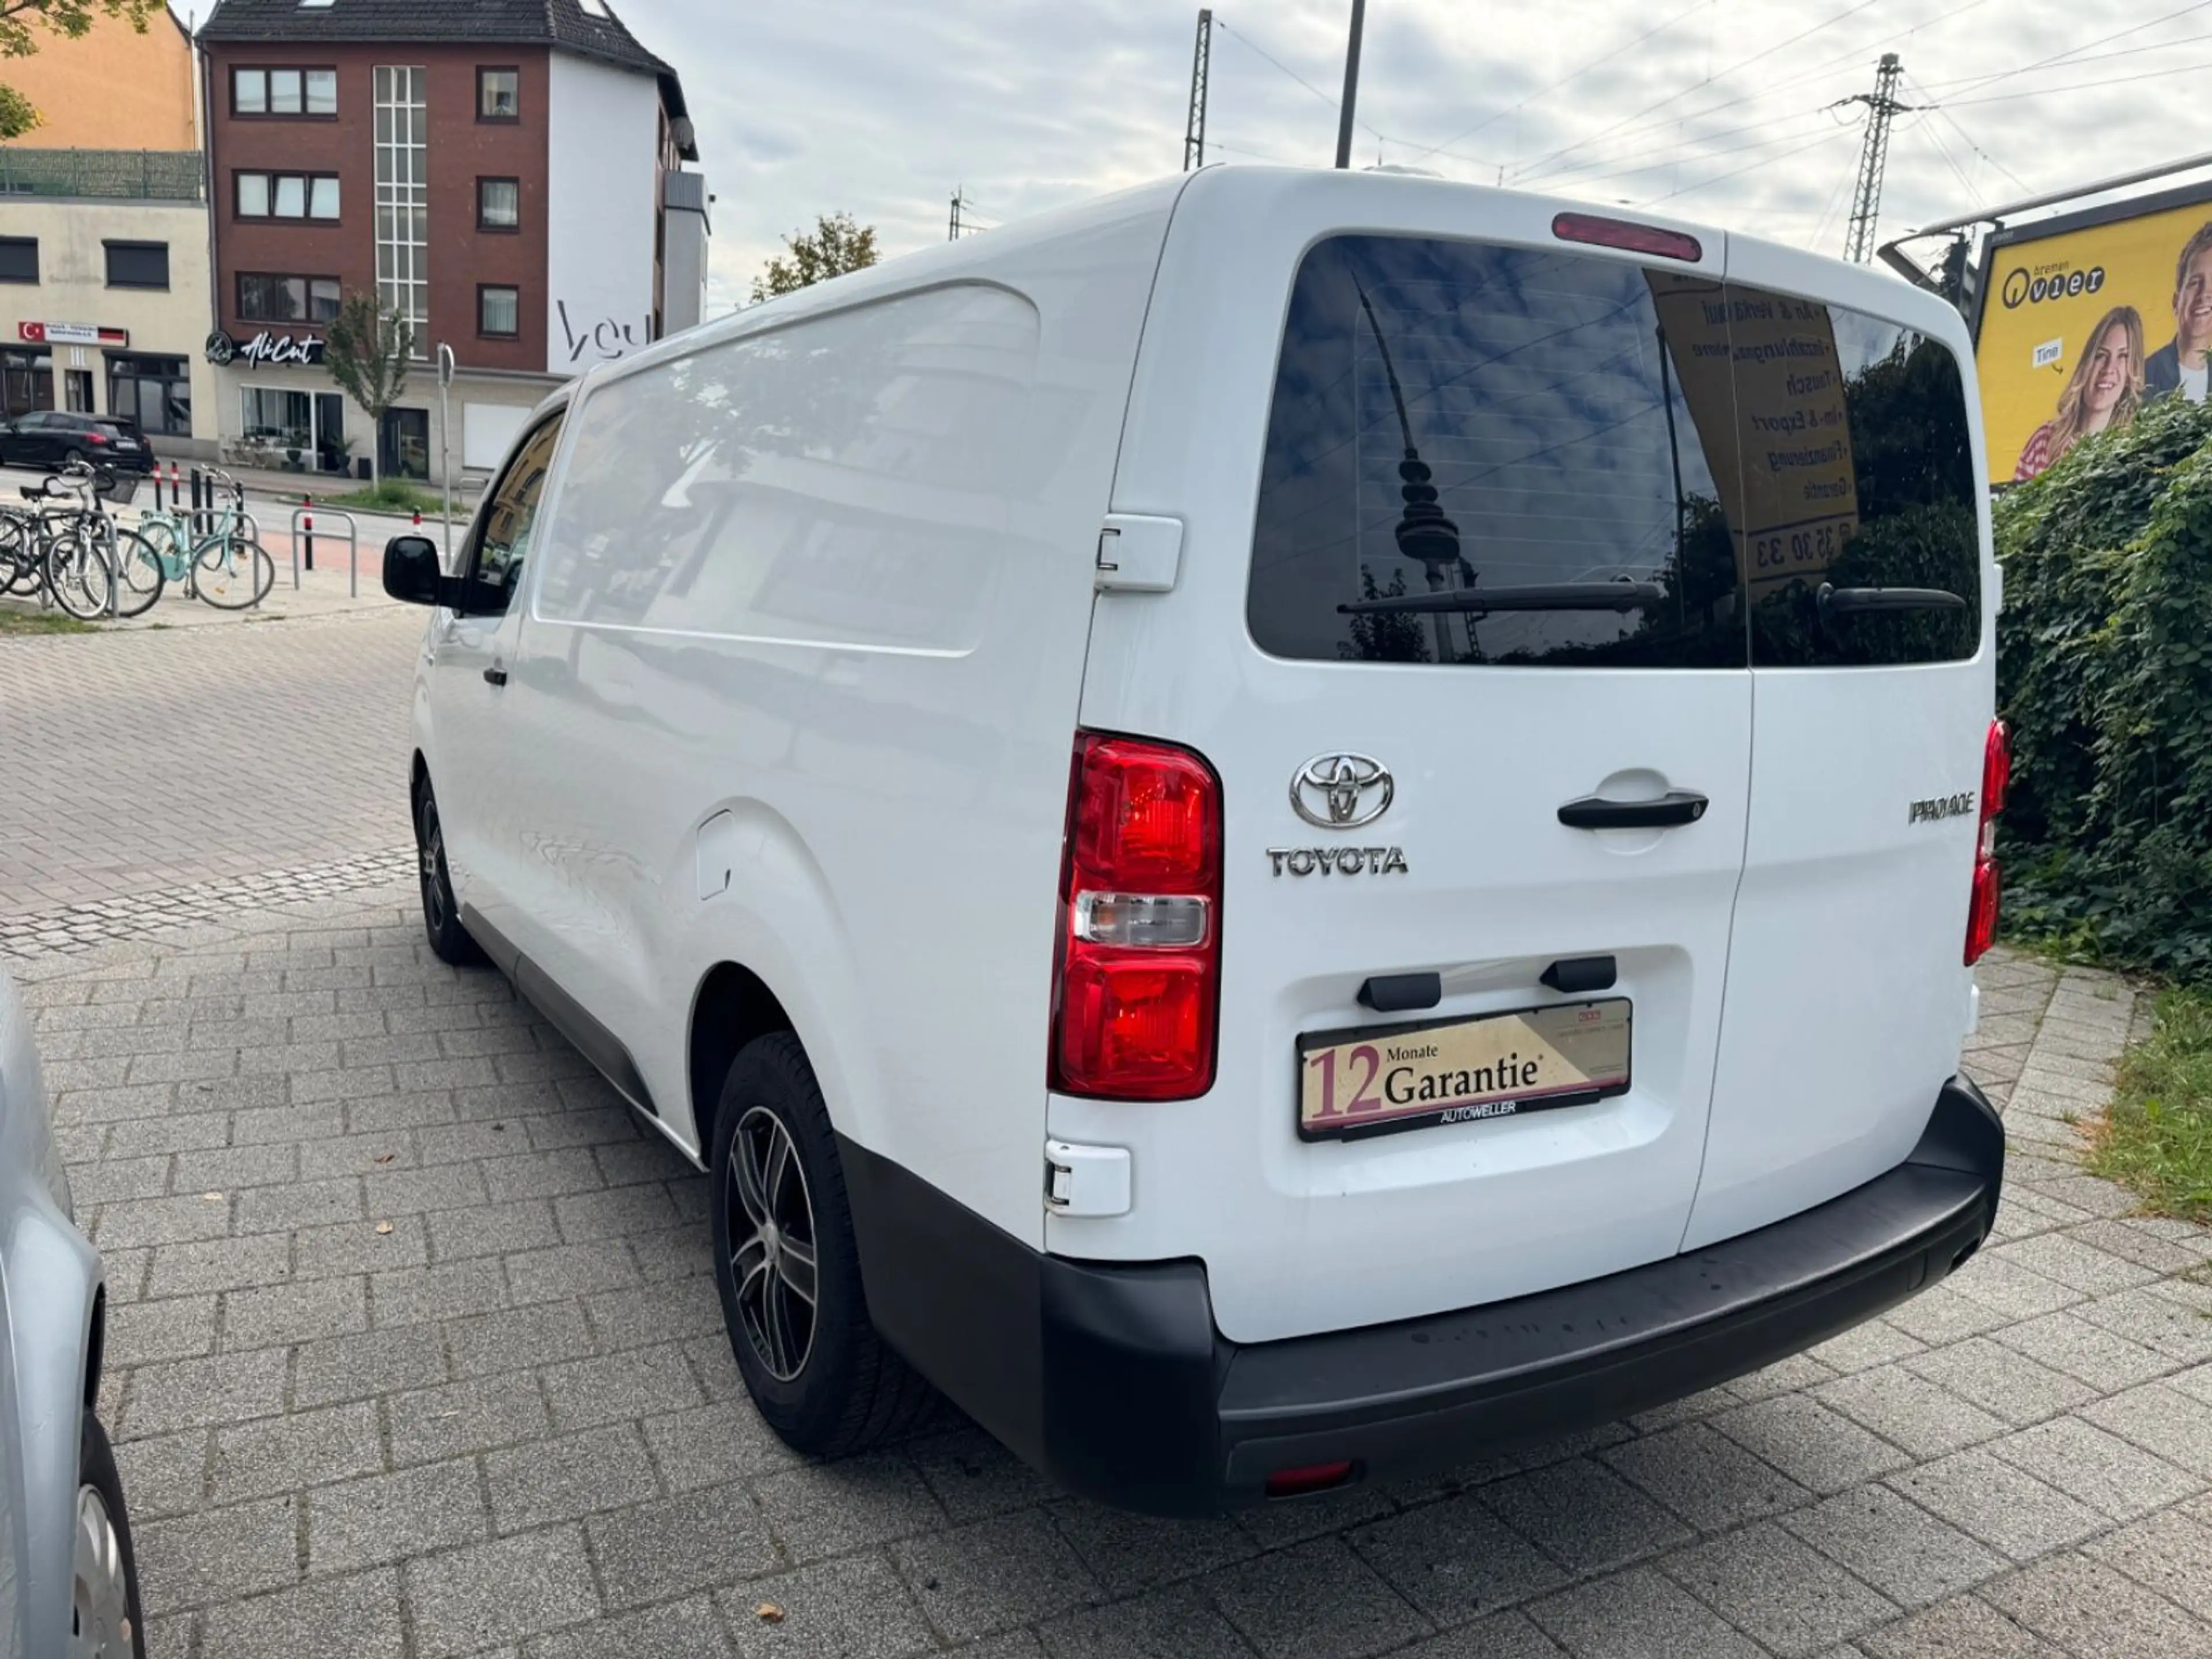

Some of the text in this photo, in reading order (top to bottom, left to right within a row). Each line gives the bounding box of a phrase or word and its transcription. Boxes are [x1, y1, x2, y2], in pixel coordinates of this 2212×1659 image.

[1908, 791, 1975, 825] PROACE
[1266, 846, 1408, 877] TOYOTA
[1310, 1044, 1438, 1118] 12 Monate
[1441, 1101, 1516, 1124] AUTOWELLER
